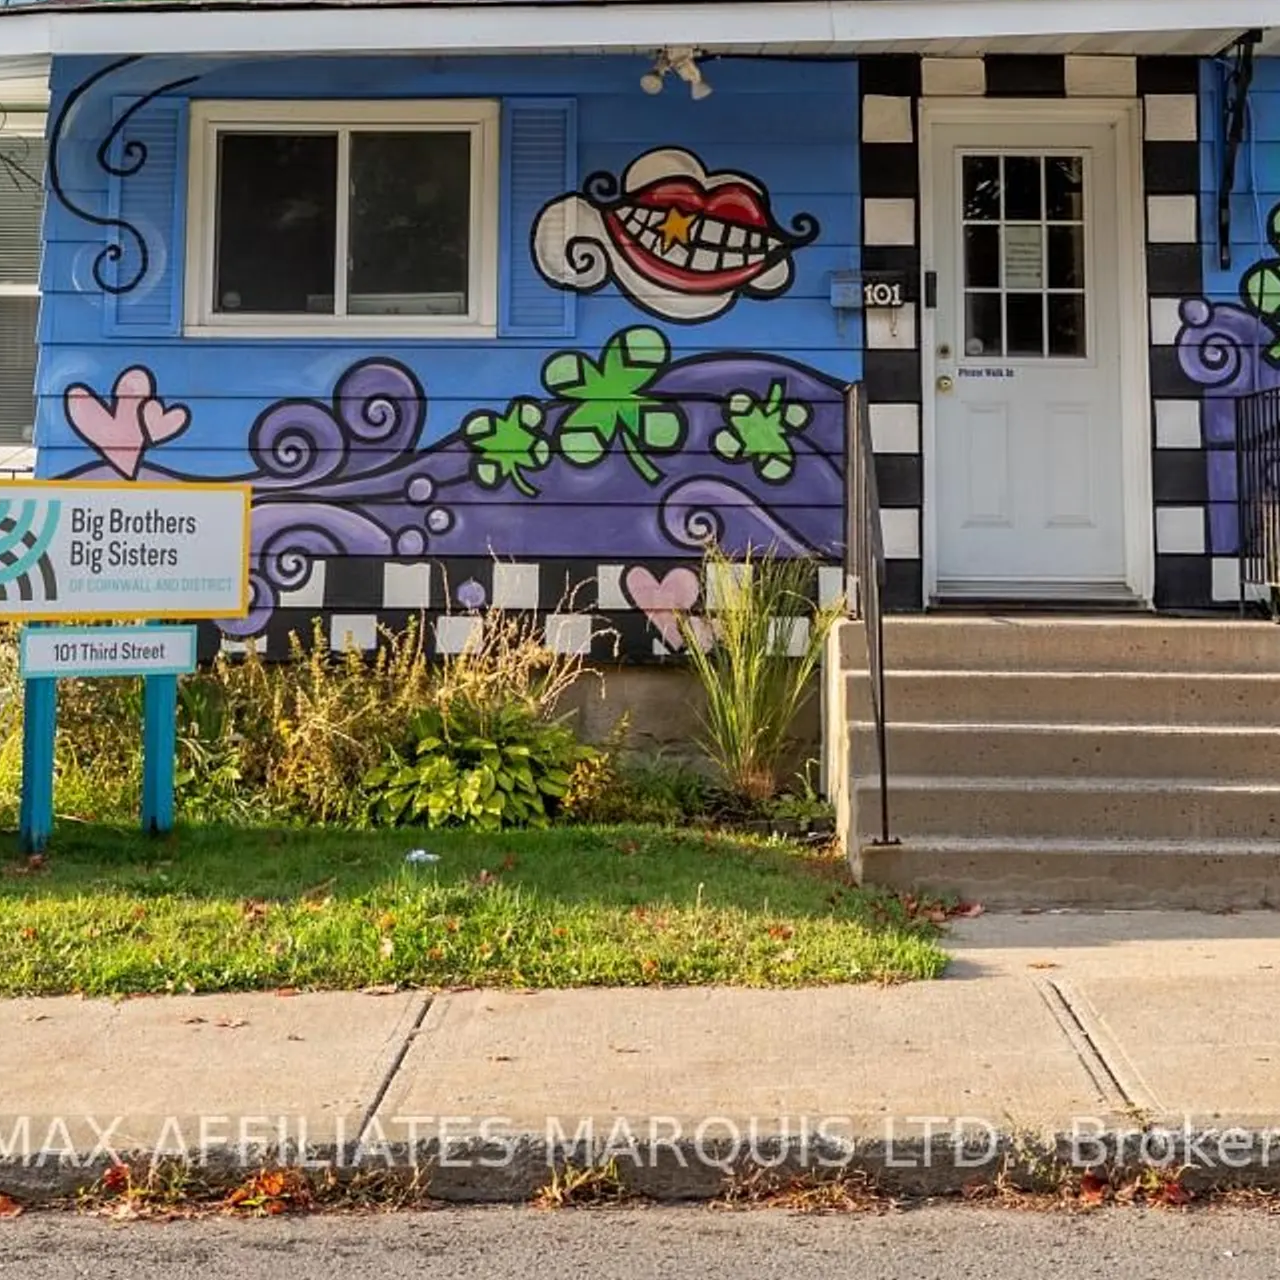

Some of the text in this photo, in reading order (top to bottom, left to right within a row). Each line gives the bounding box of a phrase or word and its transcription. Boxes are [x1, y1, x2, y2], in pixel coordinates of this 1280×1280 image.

[864, 283, 902, 305] 101
[72, 508, 196, 540] Big Brothers
[70, 540, 177, 574] Big Sisters
[70, 577, 232, 592] OF CORNWALL AND DISTRICT
[54, 642, 165, 661] 101 Third Street
